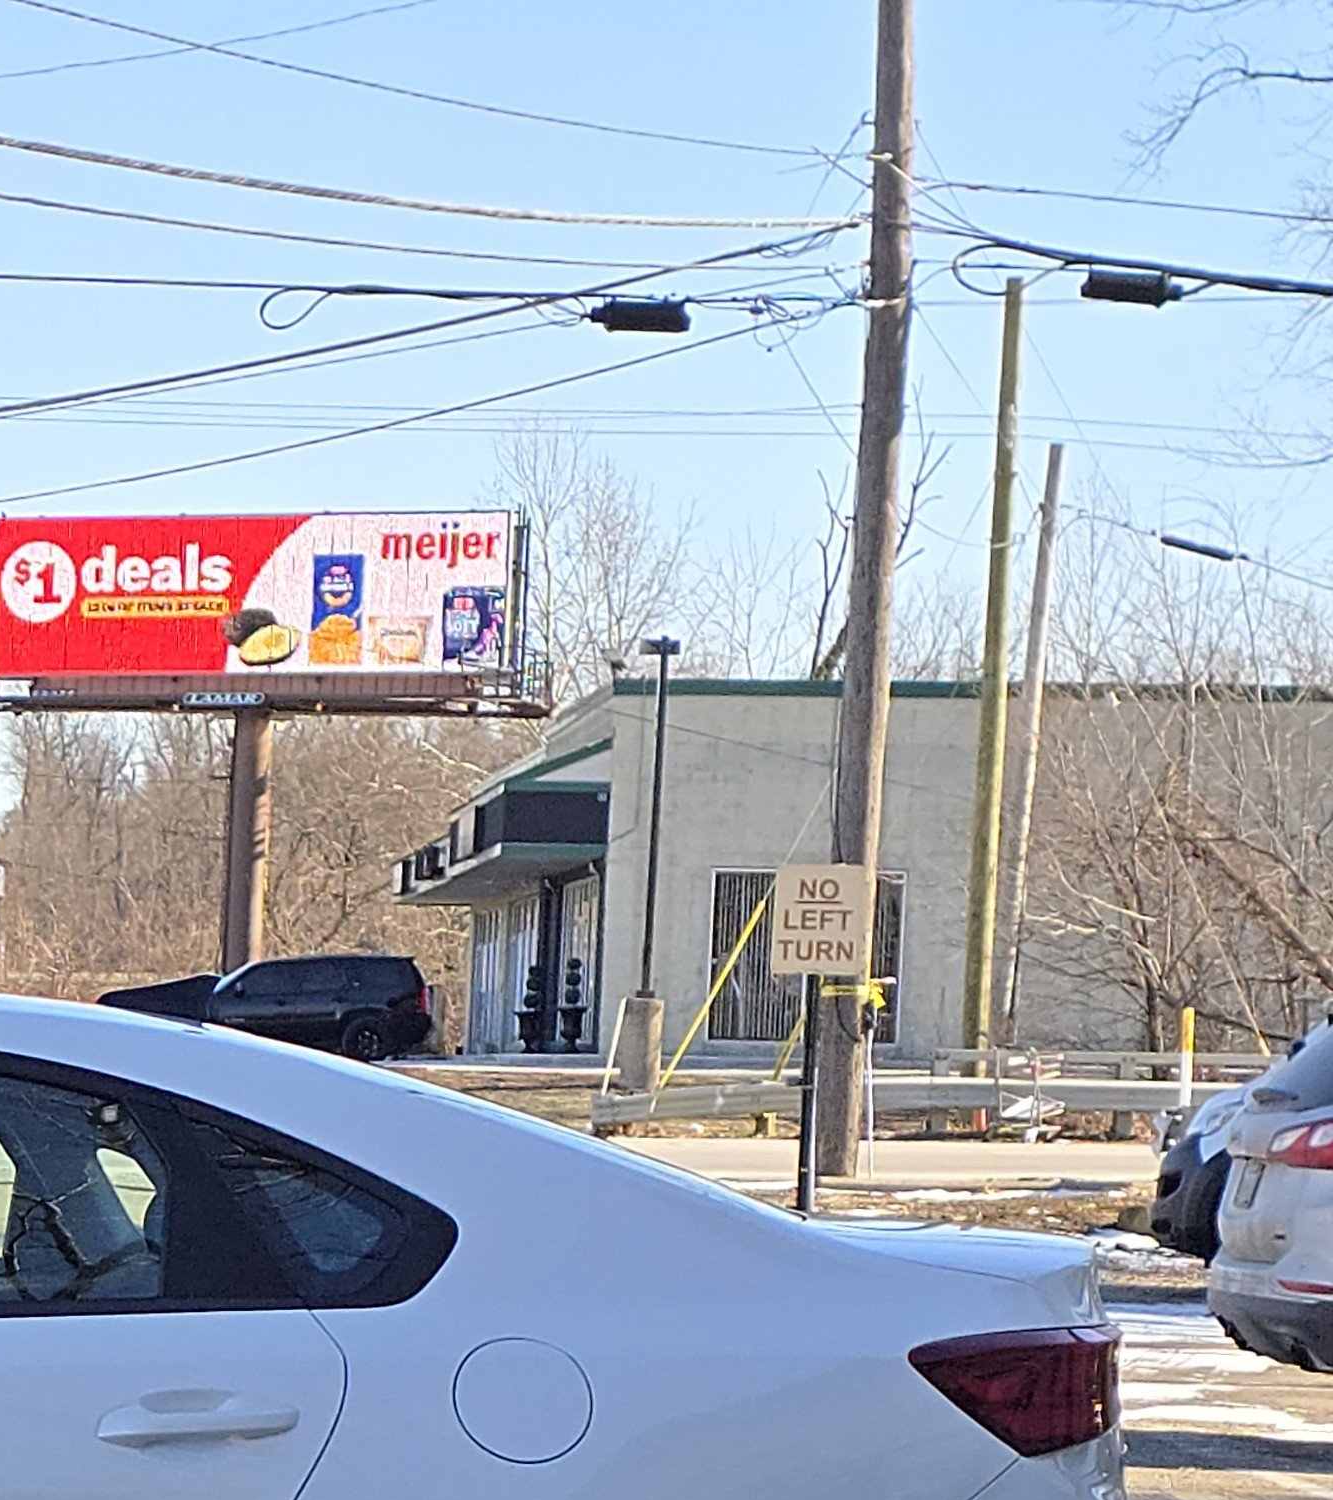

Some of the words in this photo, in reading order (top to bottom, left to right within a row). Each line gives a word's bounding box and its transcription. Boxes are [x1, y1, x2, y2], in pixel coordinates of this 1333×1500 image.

[382, 521, 500, 568] meijer
[14, 558, 62, 604] $1
[82, 543, 233, 594] deals
[799, 878, 840, 900] NO
[783, 908, 854, 931] LEFT
[777, 939, 854, 961] TURN
